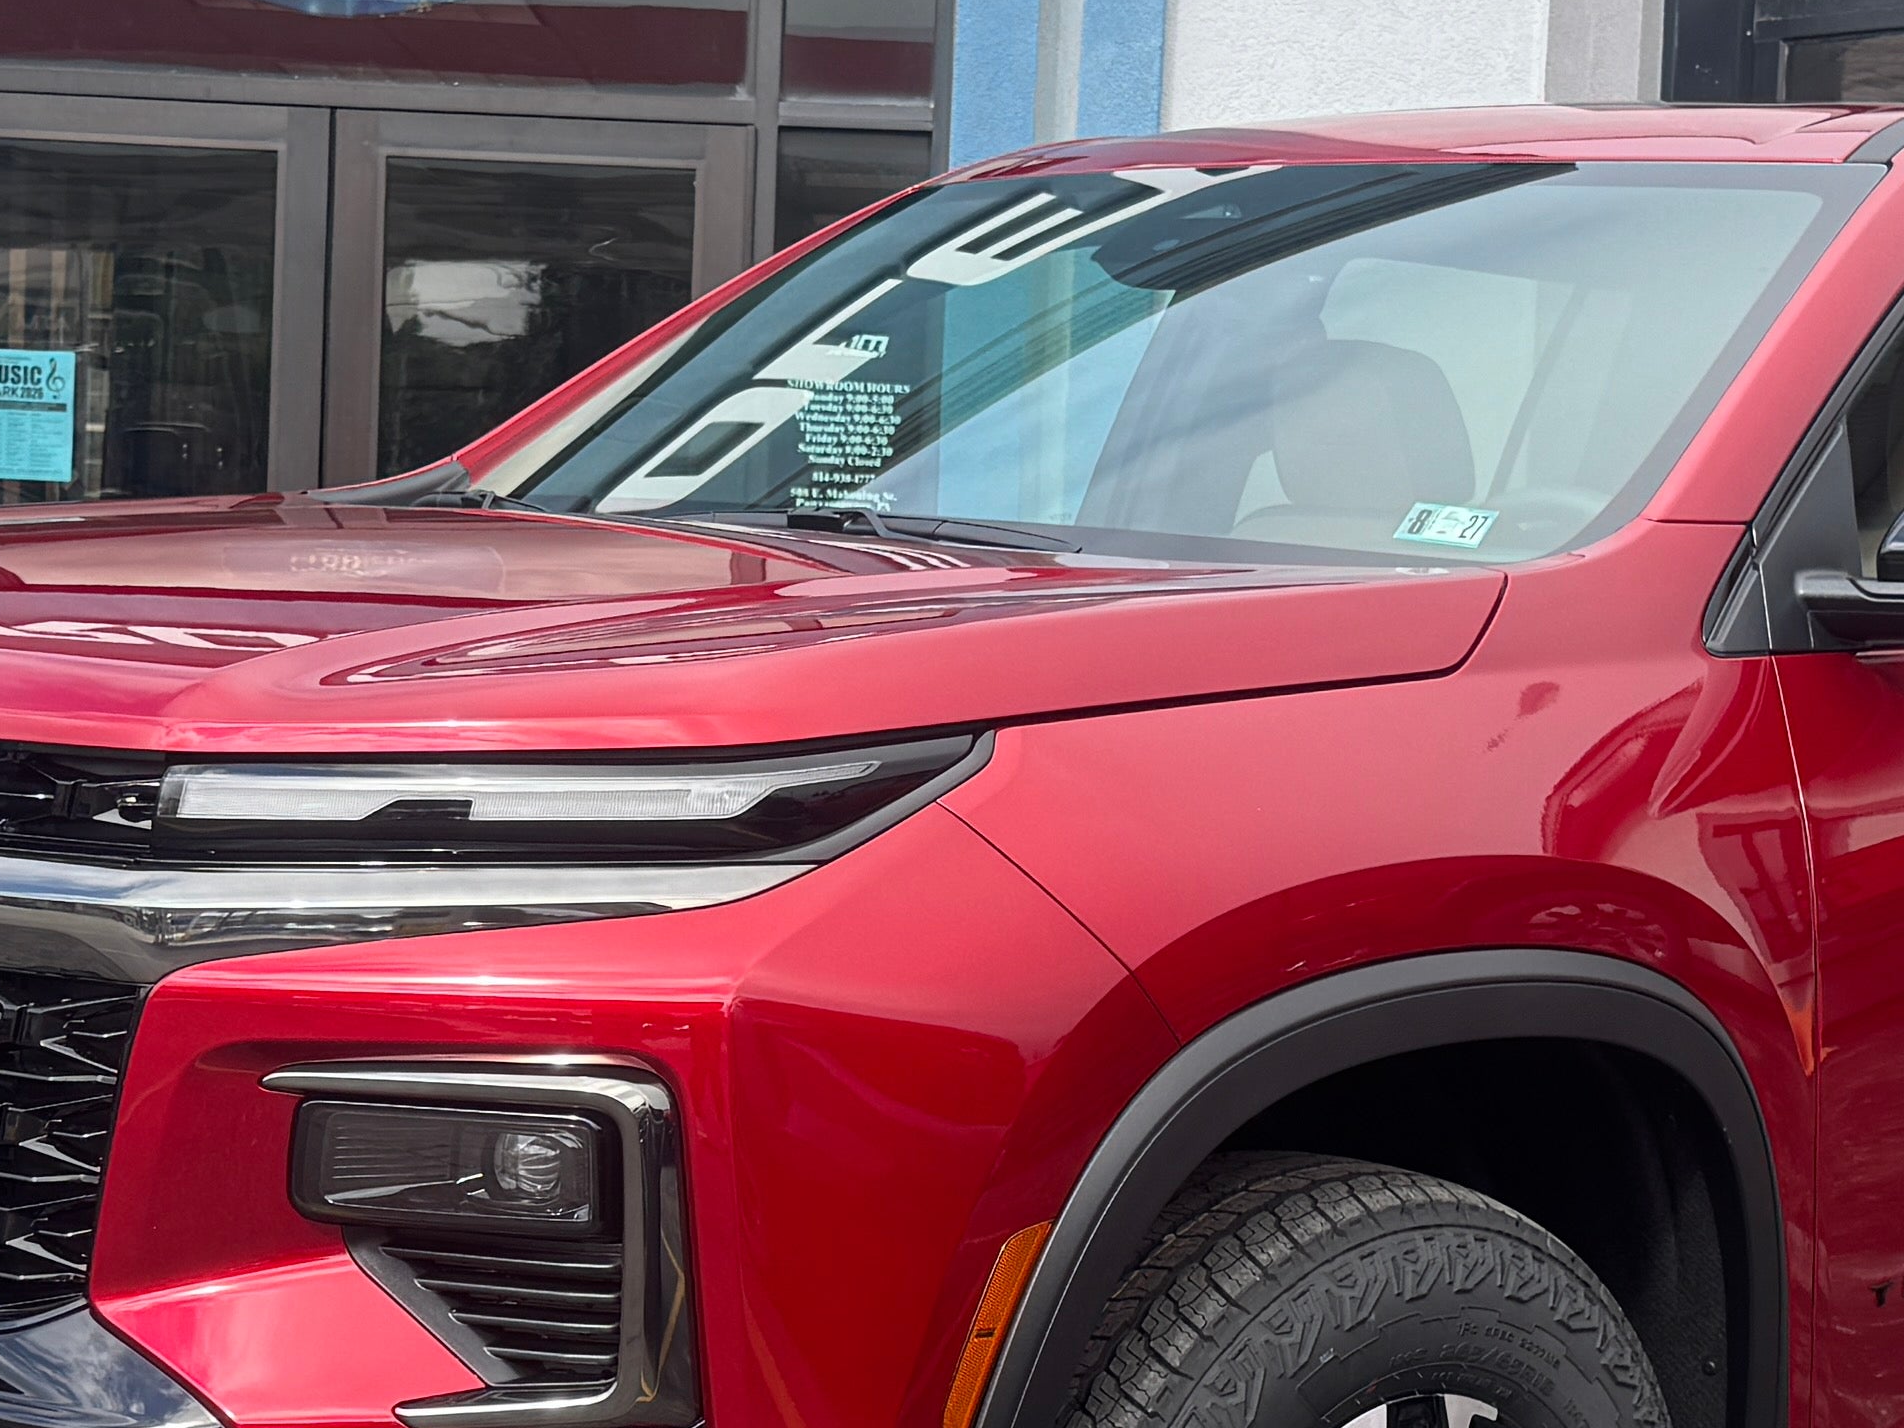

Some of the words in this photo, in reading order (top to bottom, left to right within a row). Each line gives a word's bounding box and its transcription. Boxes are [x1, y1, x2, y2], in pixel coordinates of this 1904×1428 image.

[866, 383, 911, 394] HOURS
[802, 392, 844, 405] onday
[799, 422, 845, 435] Thursday
[805, 433, 837, 445] Friday
[797, 443, 843, 456] Saturday
[808, 455, 845, 468] Sunday
[847, 456, 881, 468] Closed
[1406, 508, 1433, 535] 8
[1457, 514, 1490, 540] 27
